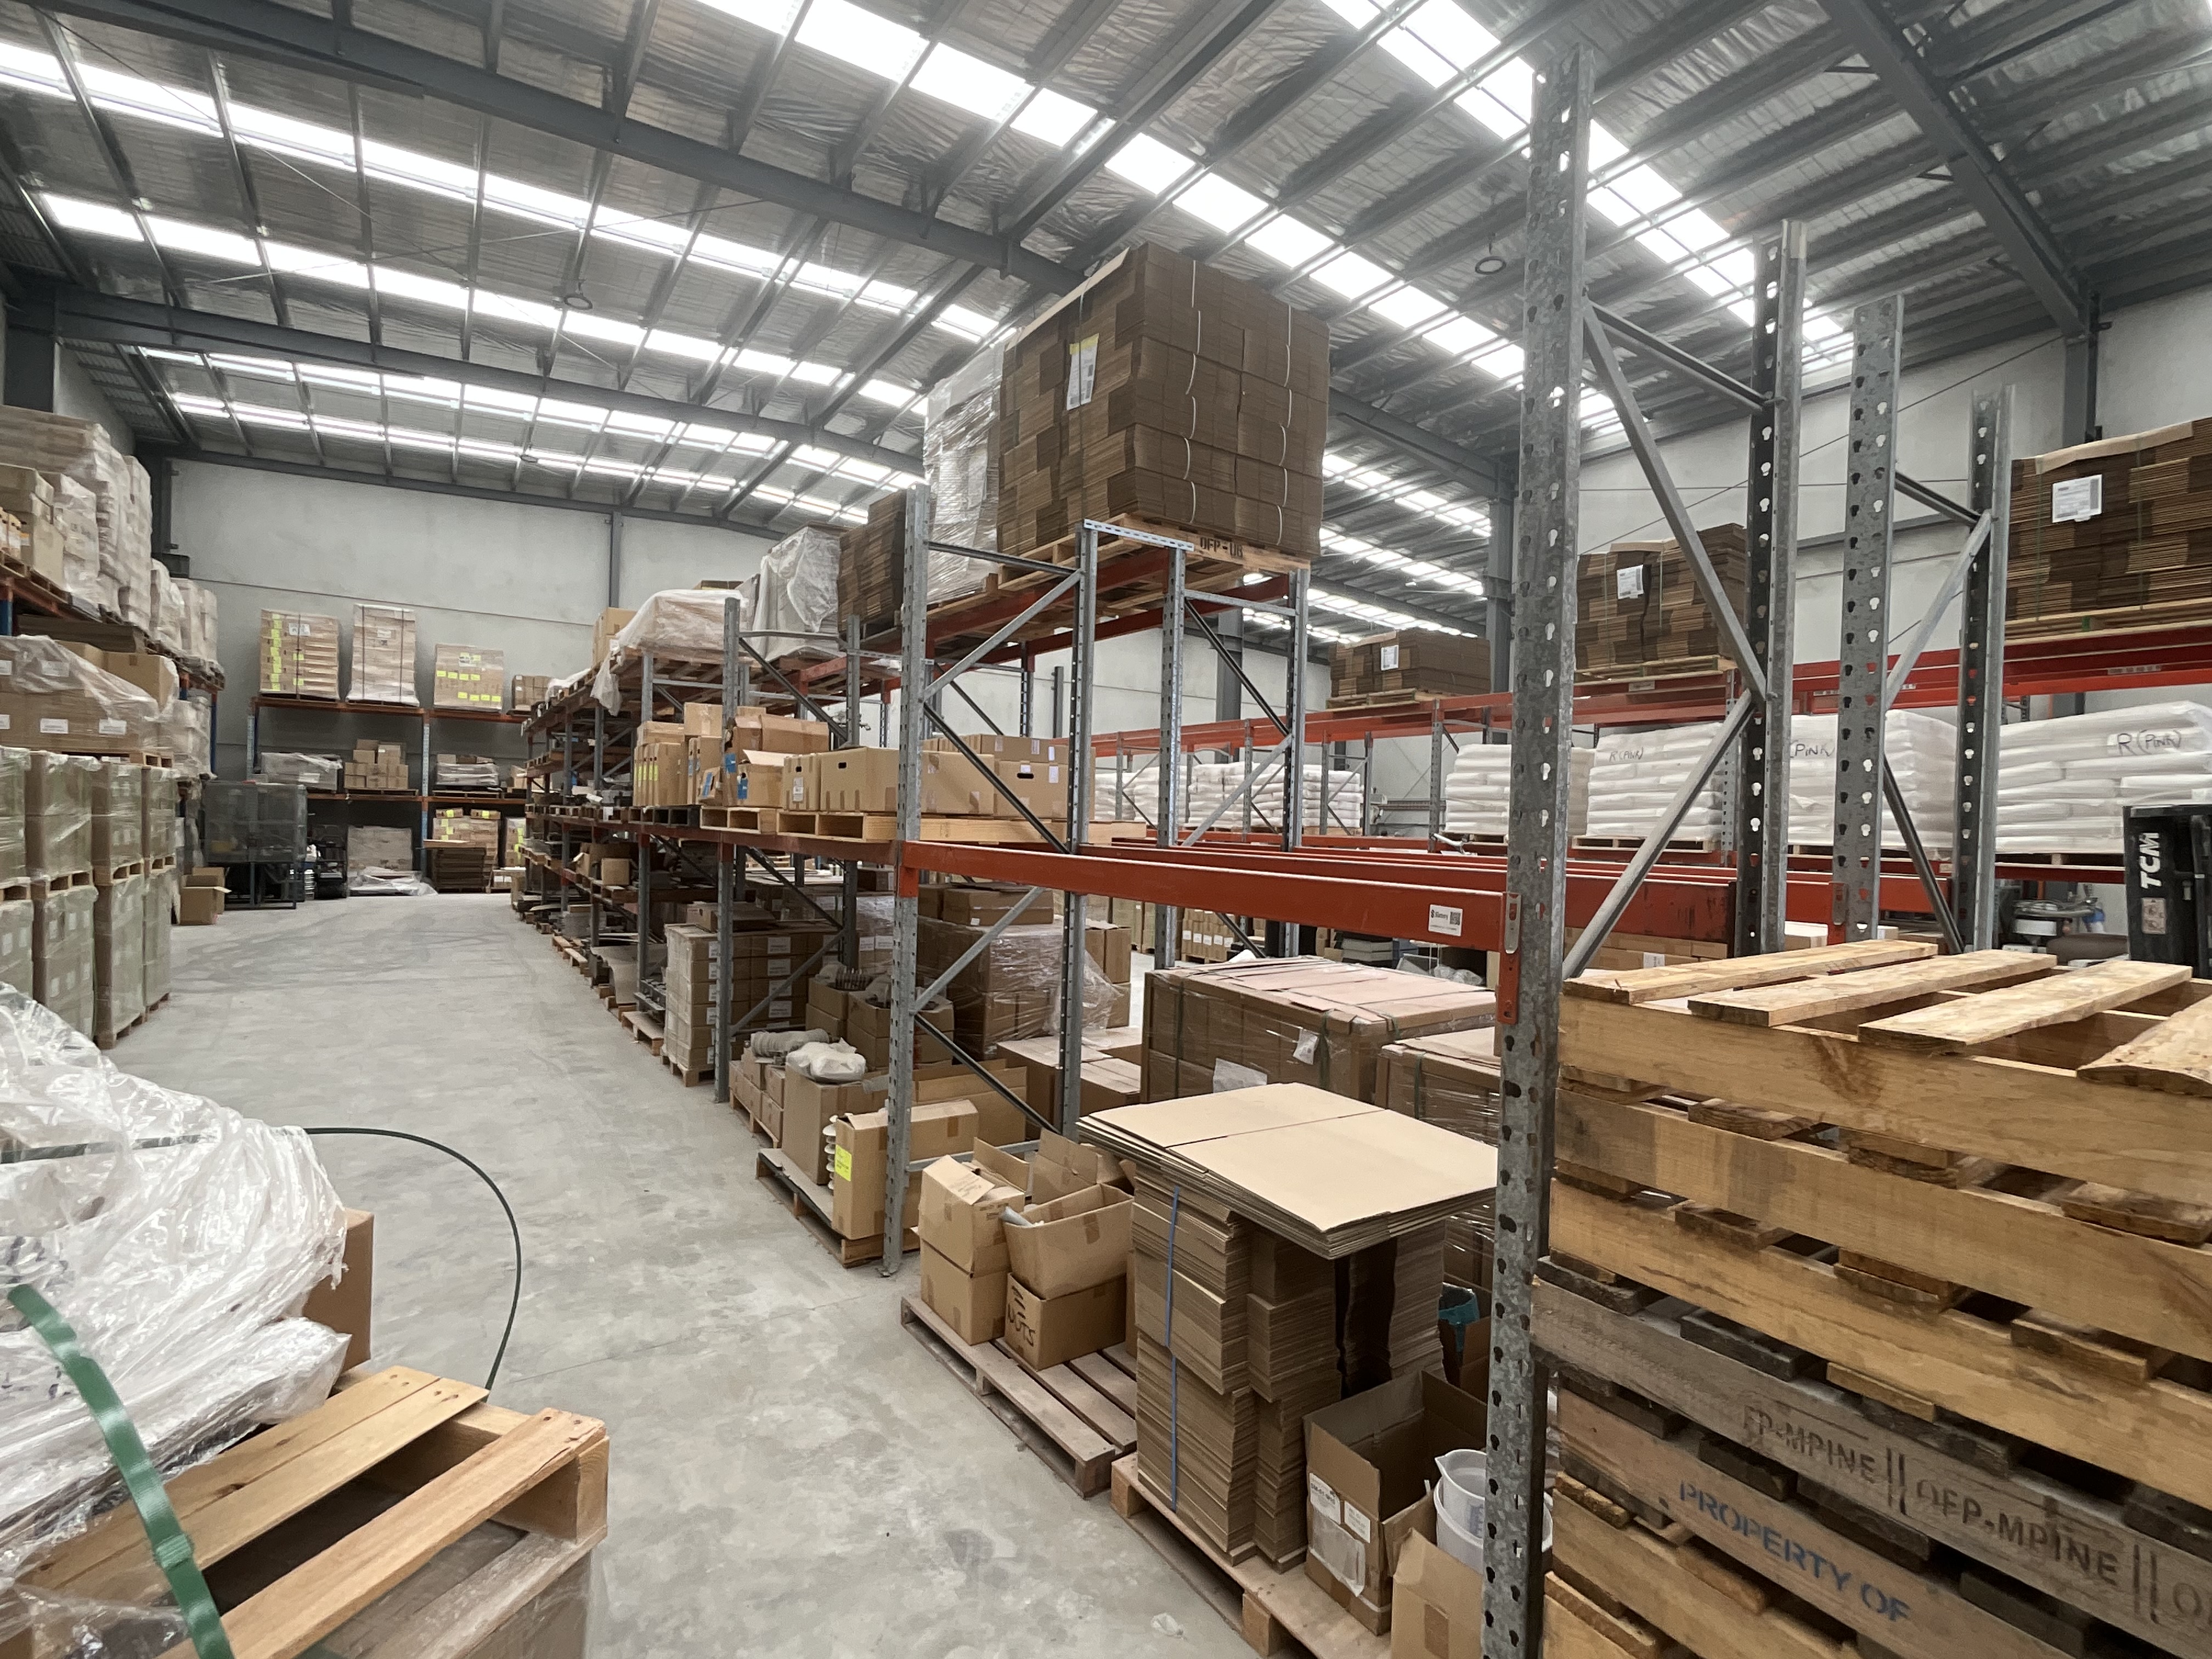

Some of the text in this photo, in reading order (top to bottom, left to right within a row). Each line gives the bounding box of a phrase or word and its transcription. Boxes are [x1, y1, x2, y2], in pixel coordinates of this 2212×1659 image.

[2117, 733, 2137, 756] R
[2139, 832, 2162, 889] TCM
[1680, 1480, 1910, 1622] PROPERTY OF
